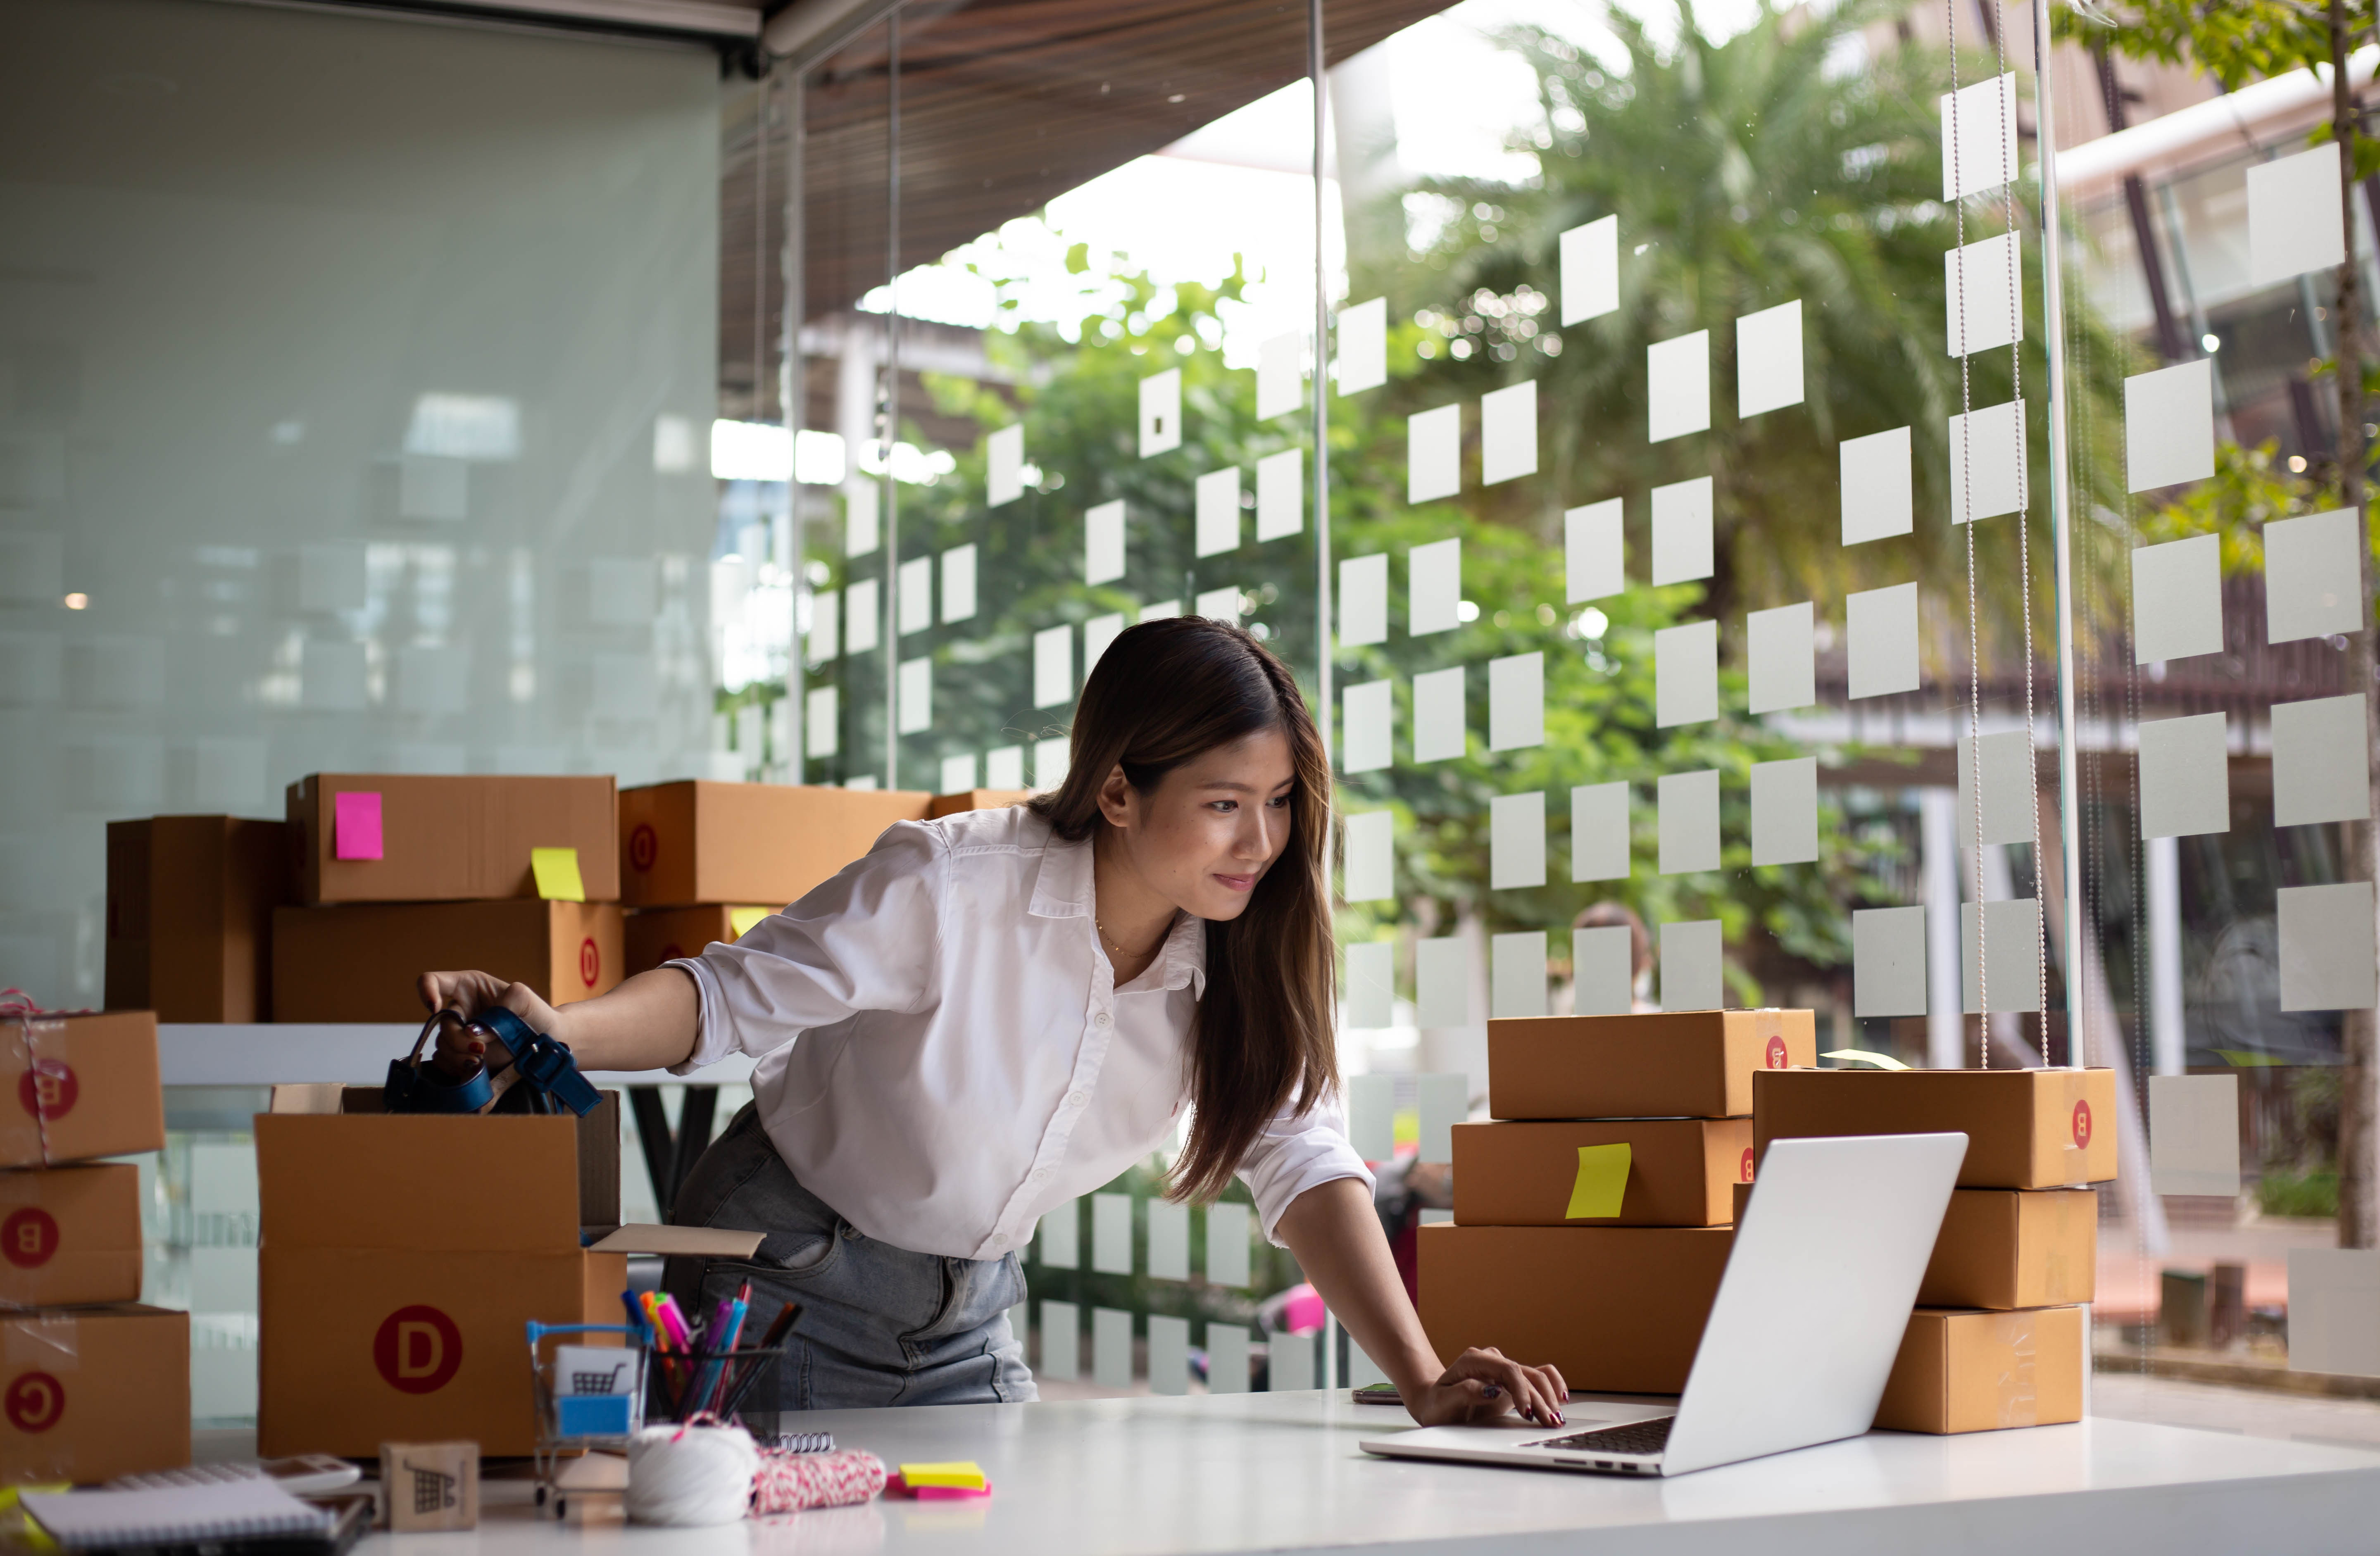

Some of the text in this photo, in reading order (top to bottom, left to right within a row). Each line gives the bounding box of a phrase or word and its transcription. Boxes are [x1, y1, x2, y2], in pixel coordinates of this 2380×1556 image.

[1772, 1048, 1781, 1068] B
[36, 1075, 60, 1104] B
[2078, 1113, 2086, 1136] B
[1745, 1159, 1753, 1181] B
[18, 1224, 40, 1253] B
[398, 1321, 443, 1378] D
[19, 1380, 51, 1425] C
